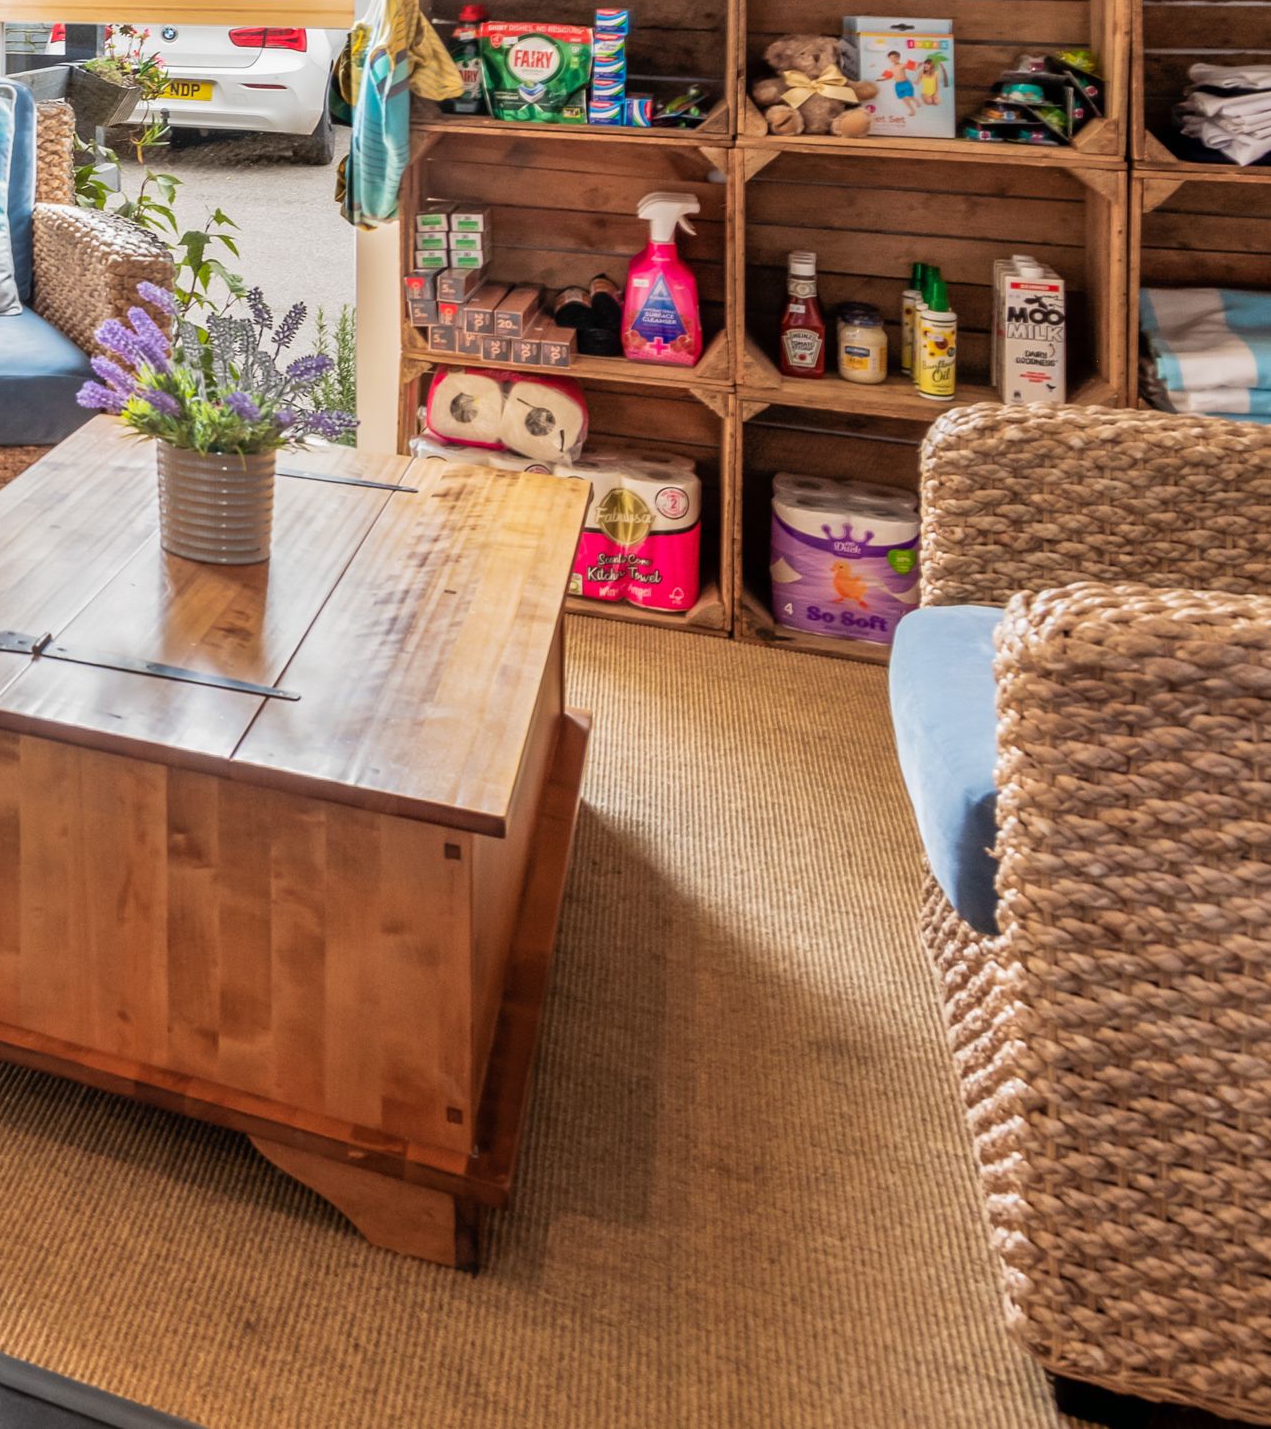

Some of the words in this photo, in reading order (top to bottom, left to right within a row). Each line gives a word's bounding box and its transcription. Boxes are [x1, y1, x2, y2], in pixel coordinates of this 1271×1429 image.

[513, 49, 554, 69] FAIRY
[459, 69, 478, 83] AIRY
[170, 81, 201, 97] NDP
[1007, 306, 1065, 325] MOO
[1006, 323, 1064, 343] MILK
[932, 369, 951, 383] Oil
[627, 566, 662, 584] Towel
[784, 602, 793, 616] 4
[806, 605, 835, 624] So
[841, 611, 888, 632] Soft
